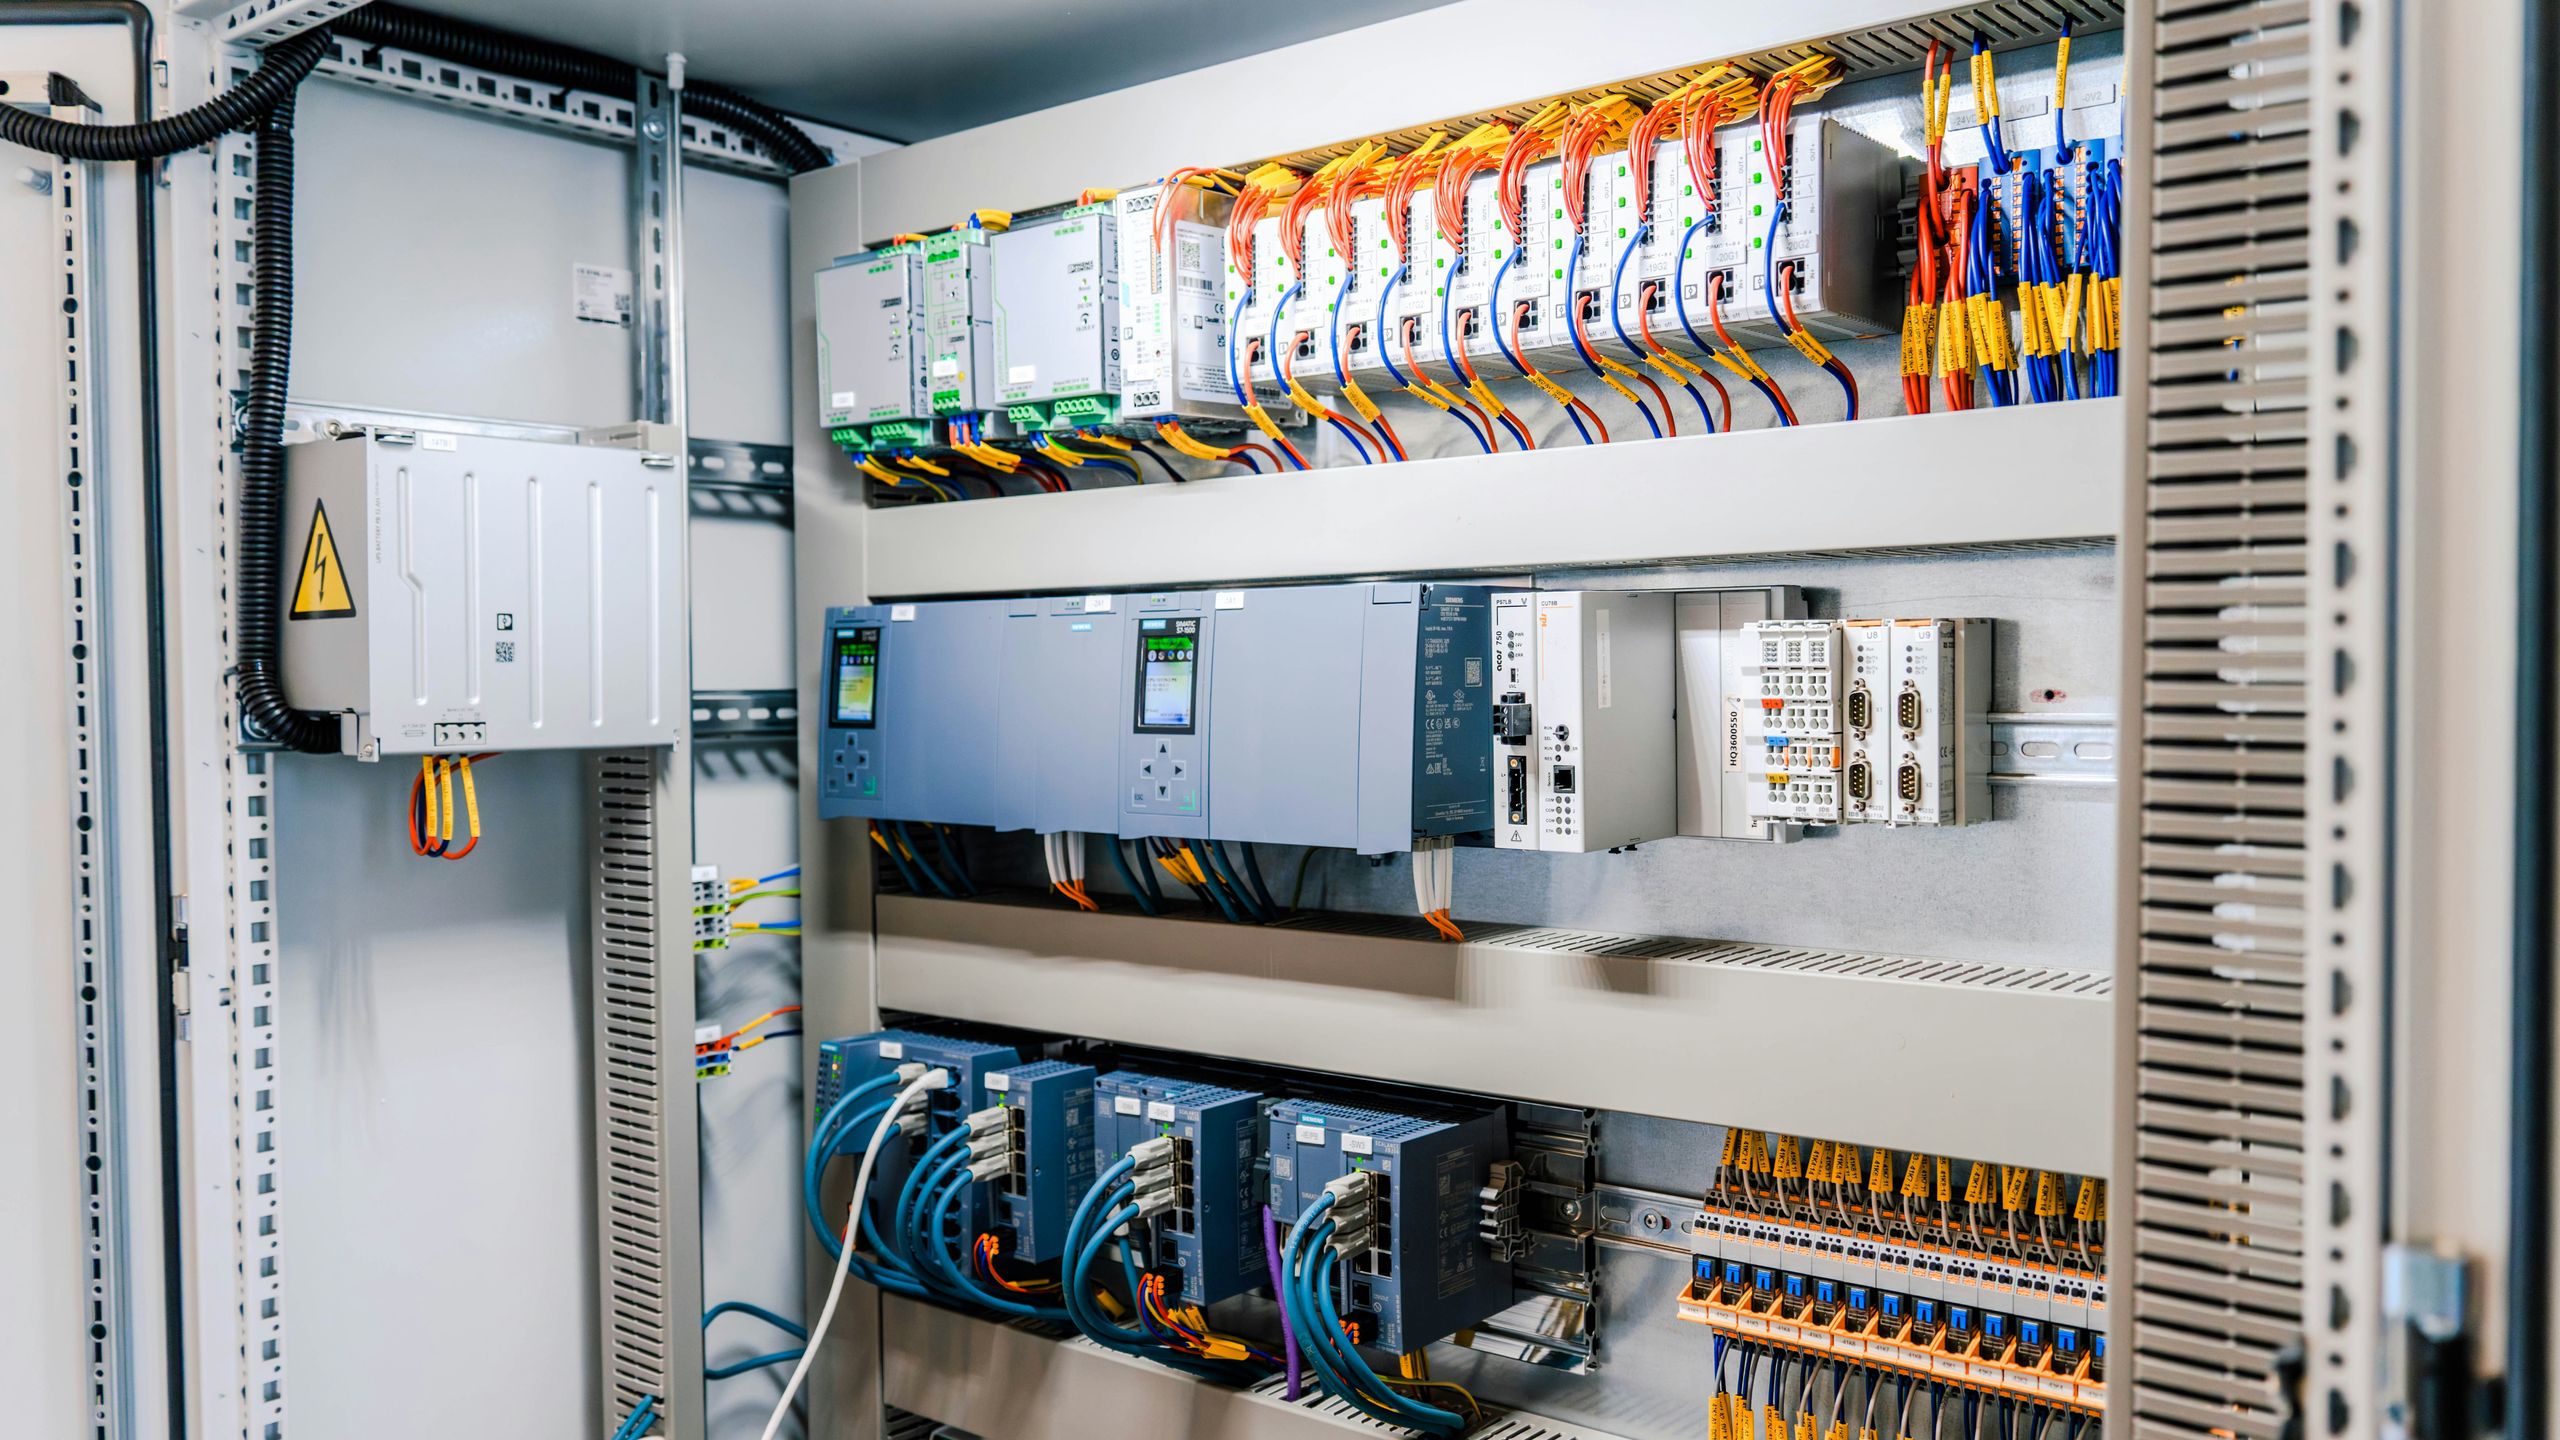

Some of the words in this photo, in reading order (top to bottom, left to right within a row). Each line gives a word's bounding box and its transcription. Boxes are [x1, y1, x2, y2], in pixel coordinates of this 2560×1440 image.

[2017, 104, 2036, 114] -0V1
[1786, 240, 1810, 250] -20G2
[1716, 252, 1739, 262] -20G1
[1176, 620, 1196, 628] SIMATIC
[1867, 632, 1878, 640] U8
[1919, 632, 1932, 640] U9
[1730, 711, 1738, 767] HQ3600550
